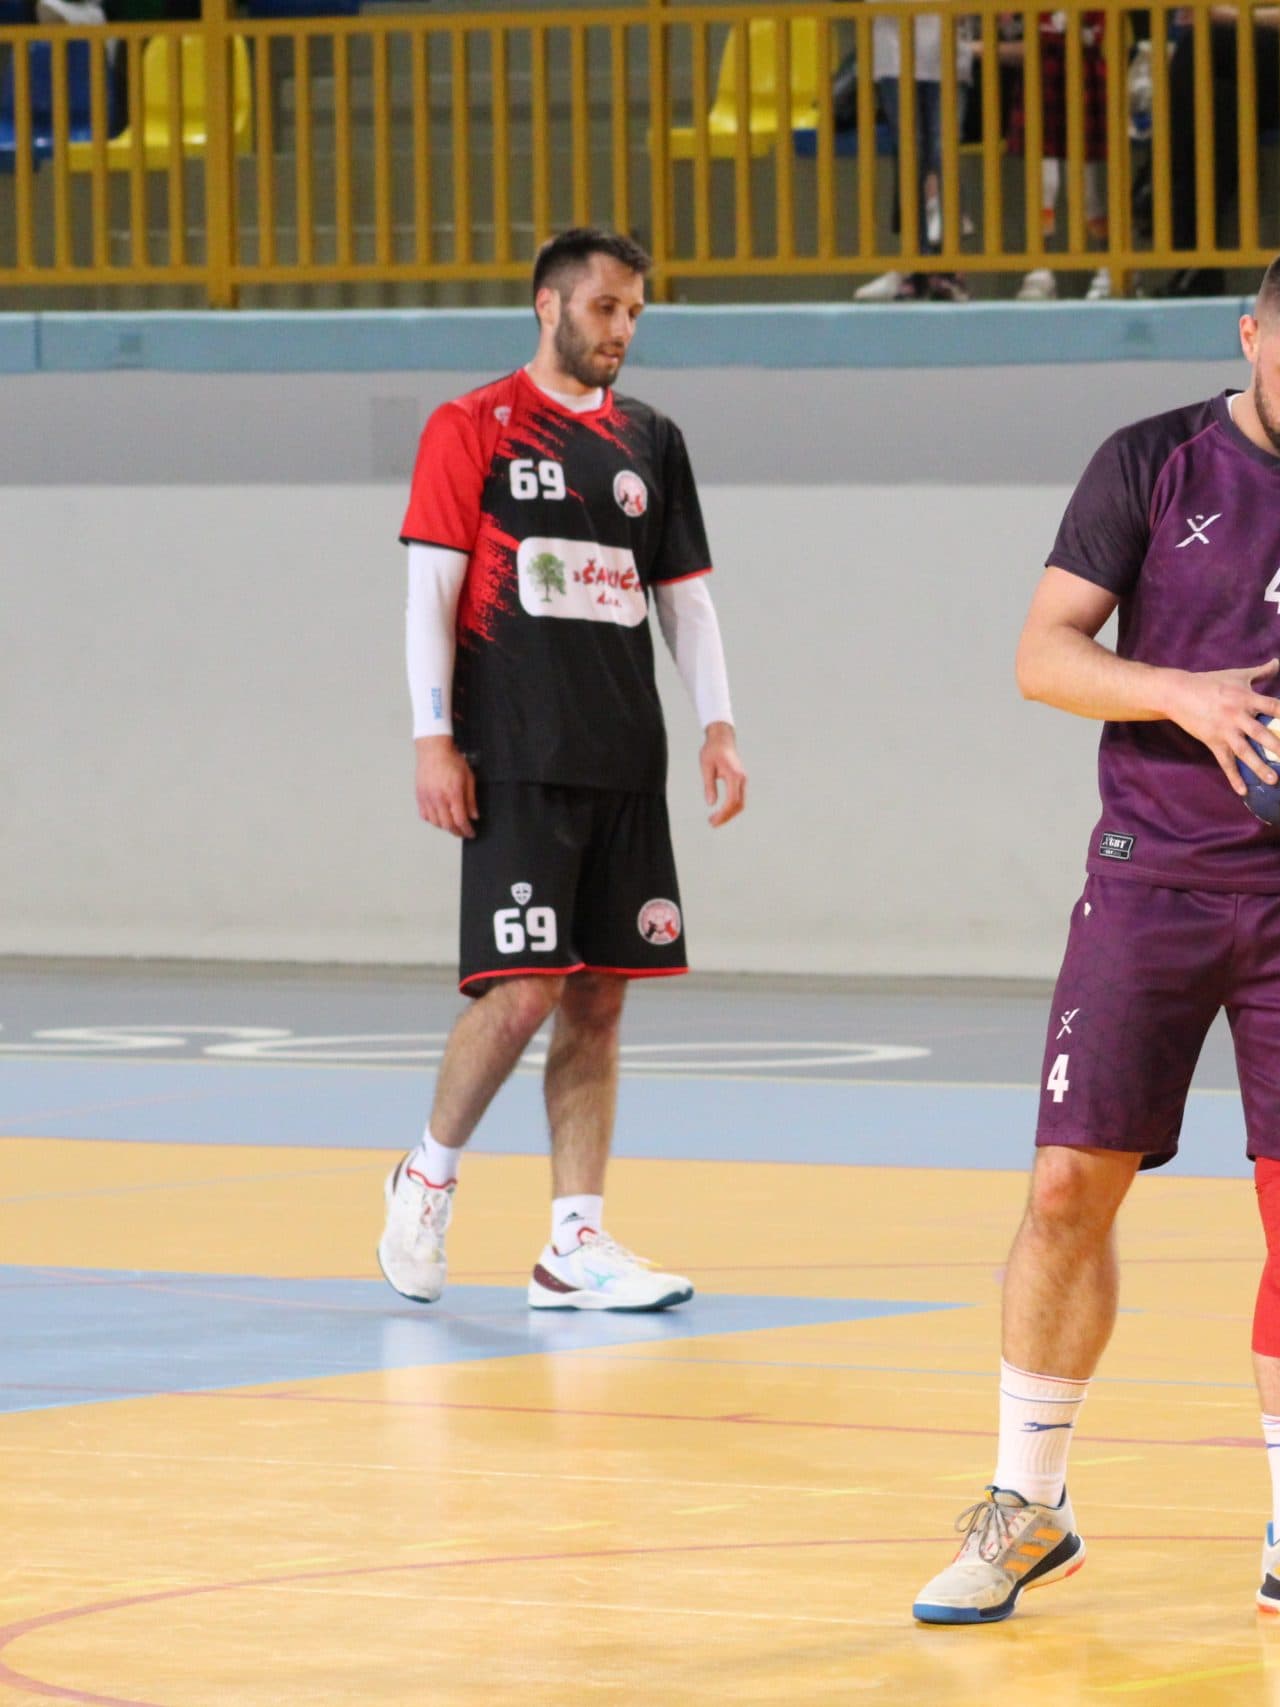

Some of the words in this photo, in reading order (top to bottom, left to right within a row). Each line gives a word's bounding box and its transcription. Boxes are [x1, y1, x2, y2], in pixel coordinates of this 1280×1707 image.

[509, 459, 566, 500] 69
[493, 906, 557, 954] 69
[1046, 1053, 1070, 1103] 4
